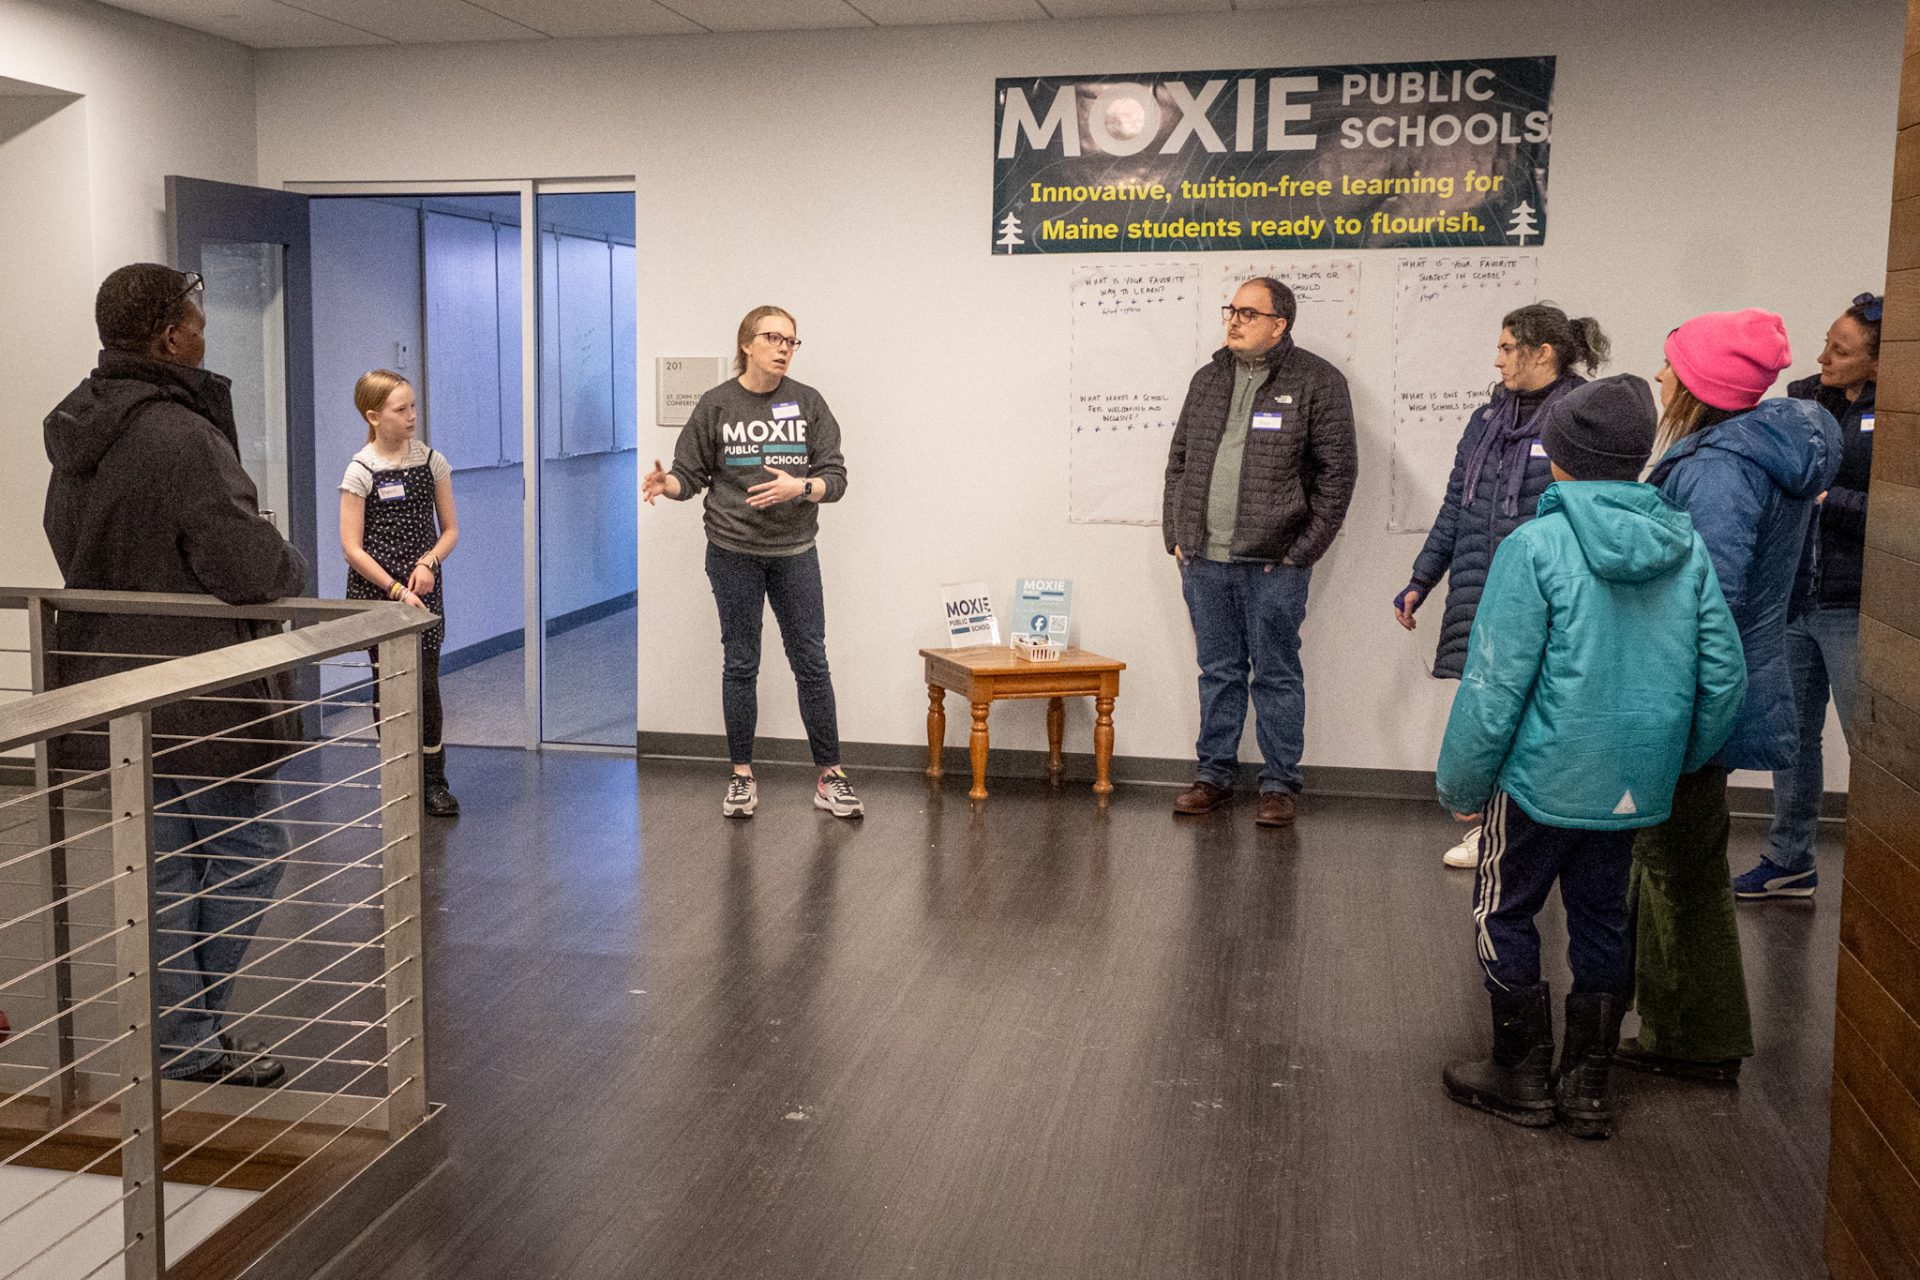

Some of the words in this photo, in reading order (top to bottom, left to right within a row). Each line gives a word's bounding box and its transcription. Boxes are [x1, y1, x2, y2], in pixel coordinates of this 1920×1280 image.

[1341, 69, 1496, 106] PUBLIC
[998, 76, 1319, 159] MOXIE
[1340, 110, 1550, 150] SCHOOLS
[1030, 180, 1172, 204] Innovative,
[1181, 175, 1332, 200] tuition-free
[1342, 172, 1455, 200] learning
[1464, 171, 1504, 193] for
[1042, 218, 1119, 241] Maine
[1127, 215, 1241, 240] students
[1251, 213, 1325, 241] ready
[1334, 215, 1362, 235] to
[1370, 211, 1486, 236] flourish.
[1402, 261, 1426, 269] WHAT
[1453, 261, 1471, 269] YOUR
[1480, 260, 1517, 269] FAVORITE
[1084, 276, 1108, 286] WHAT
[1123, 277, 1144, 285] YOUR
[1149, 276, 1185, 284] FAVORITE
[1419, 273, 1450, 282] SUBJECT
[1456, 272, 1466, 280] IN
[1119, 288, 1129, 296] TO
[1290, 283, 1321, 292] SHOULD
[666, 361, 682, 370] 201
[1080, 394, 1101, 403] WHAT
[1143, 393, 1169, 401] SCHOOL
[1400, 392, 1425, 400] WHAT
[1443, 391, 1458, 399] ONE
[1409, 404, 1427, 412] WISH
[1431, 403, 1460, 412] SCHOOLS
[722, 420, 808, 443] MOXIE
[724, 444, 760, 455] PUBLIC
[764, 455, 808, 465] SCHOOLS
[1023, 579, 1066, 591] MOXIE
[946, 597, 992, 618] MOXIE
[949, 618, 968, 627] PUBLIC
